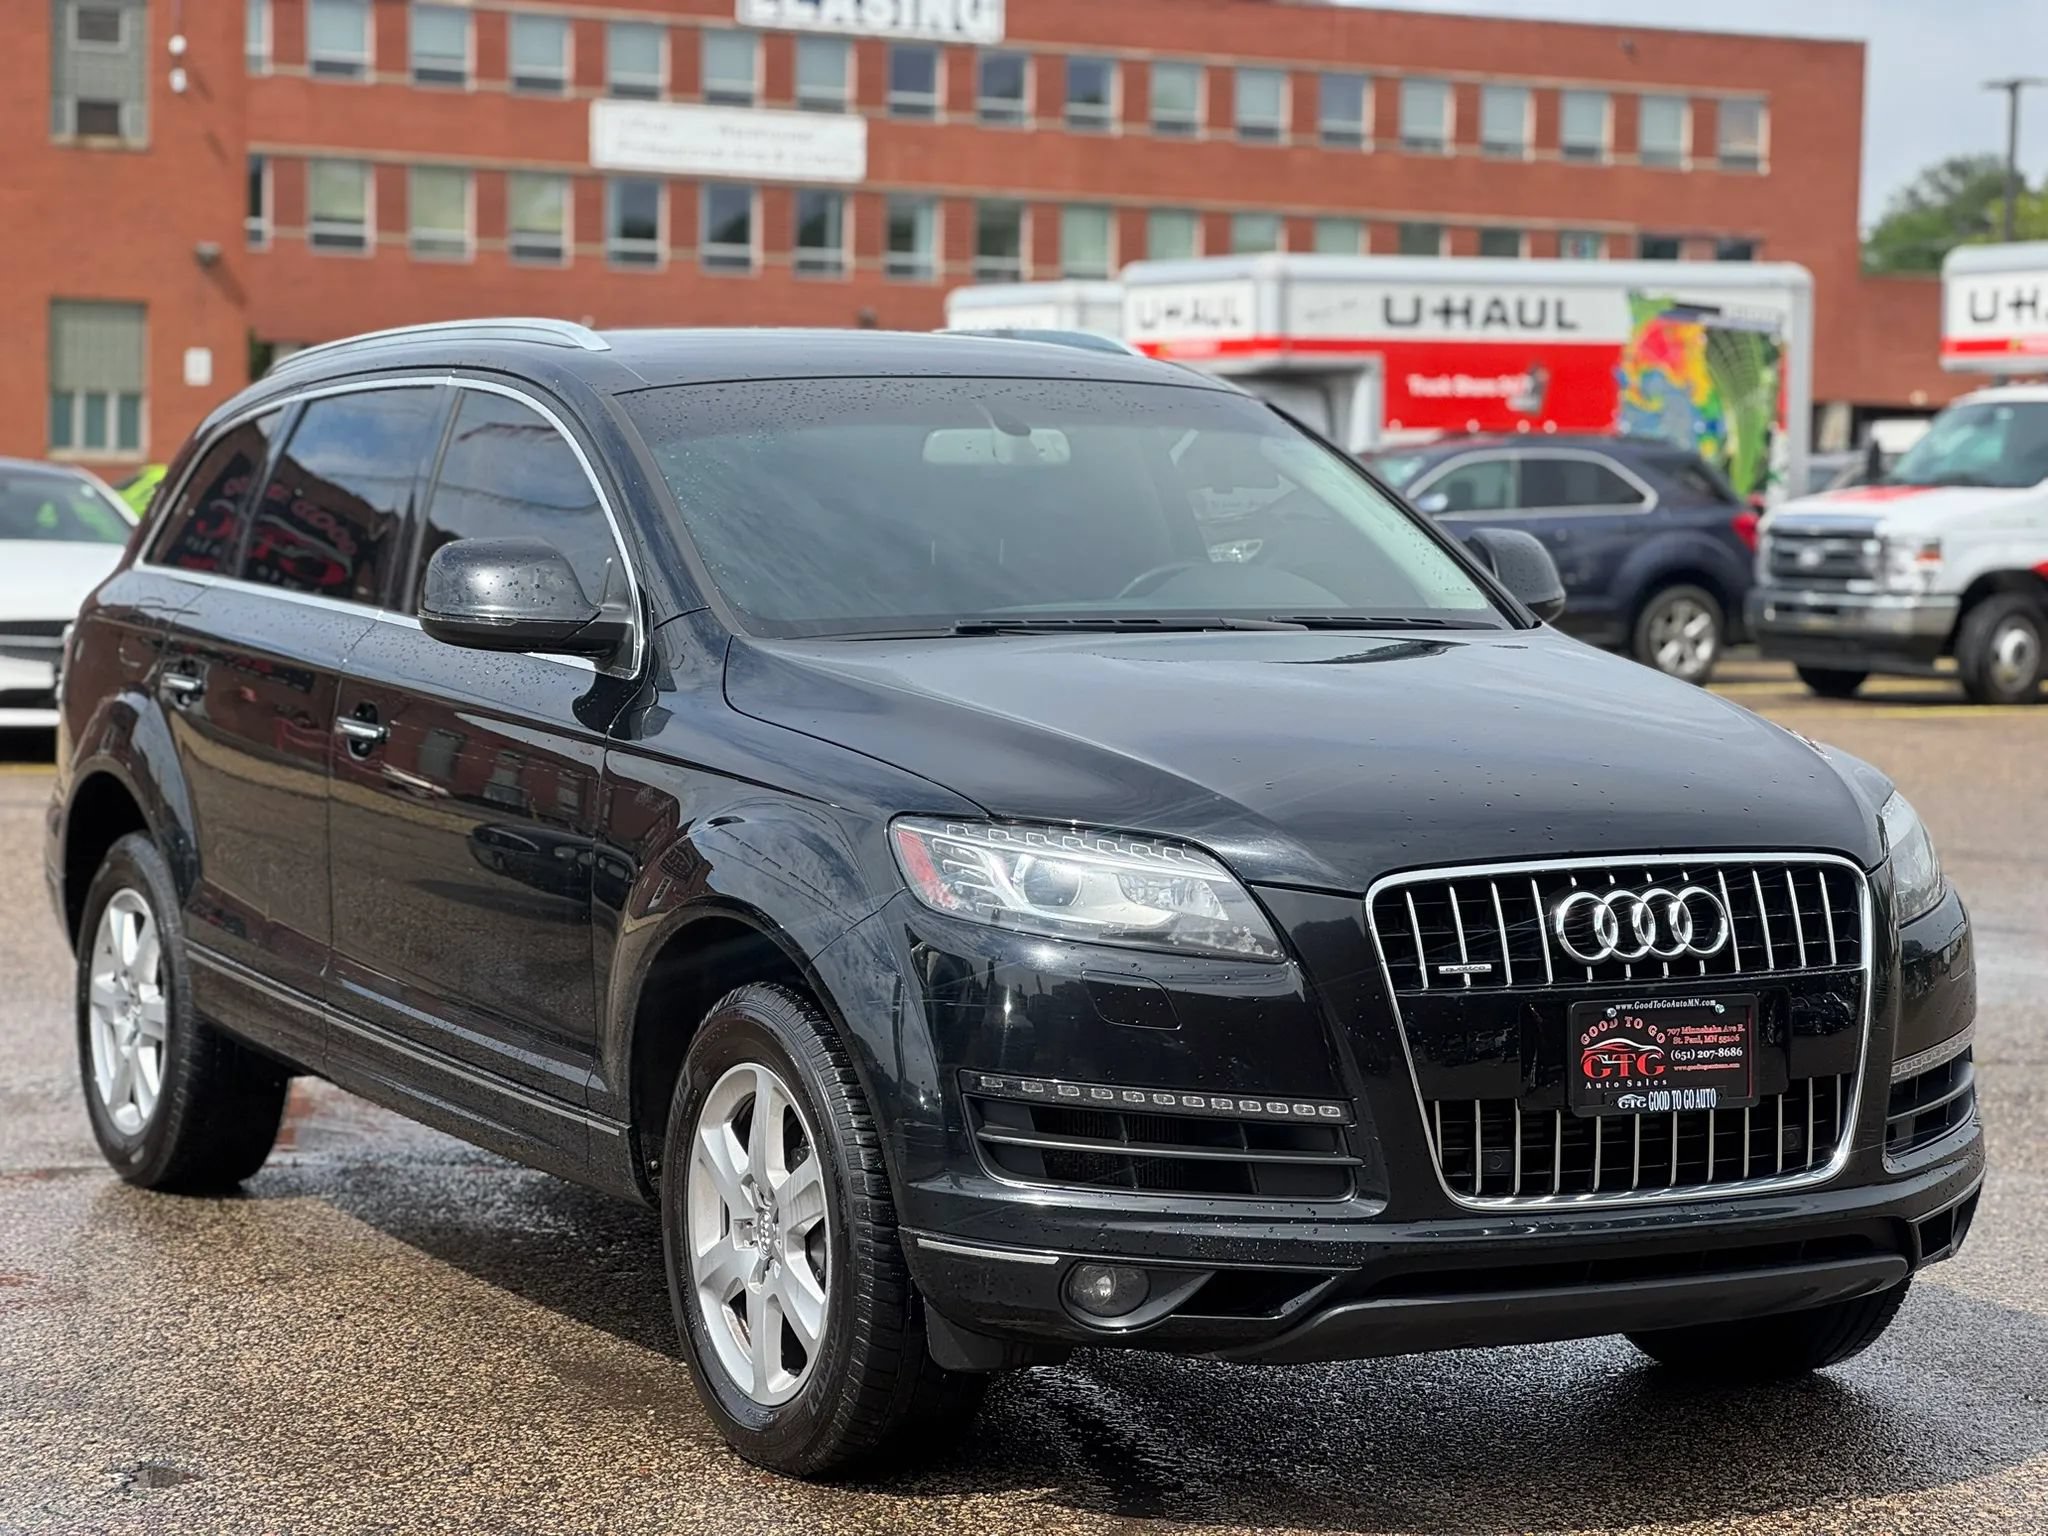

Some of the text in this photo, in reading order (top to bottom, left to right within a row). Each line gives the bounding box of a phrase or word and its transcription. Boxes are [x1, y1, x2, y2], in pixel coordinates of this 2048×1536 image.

[1383, 295, 1579, 329] U-HAUL
[1968, 287, 2048, 323] U-H
[1615, 998, 1716, 1010] www.GoodToGoAutoMN.com
[1581, 1016, 1666, 1045] GOOD TO GO
[1667, 1028, 1680, 1036] 707
[1722, 1025, 1737, 1033] Ave
[1672, 1037, 1683, 1045] St.
[1684, 1035, 1703, 1045] Paul,
[1703, 1035, 1717, 1043] MN
[1670, 1047, 1743, 1061] (651) 207-8686
[1585, 1078, 1667, 1090] Auto Sales
[1648, 1090, 1670, 1111] GOOD
[1671, 1089, 1682, 1110] TO
[1683, 1089, 1695, 1110] GO
[1695, 1087, 1717, 1109] AUTO
